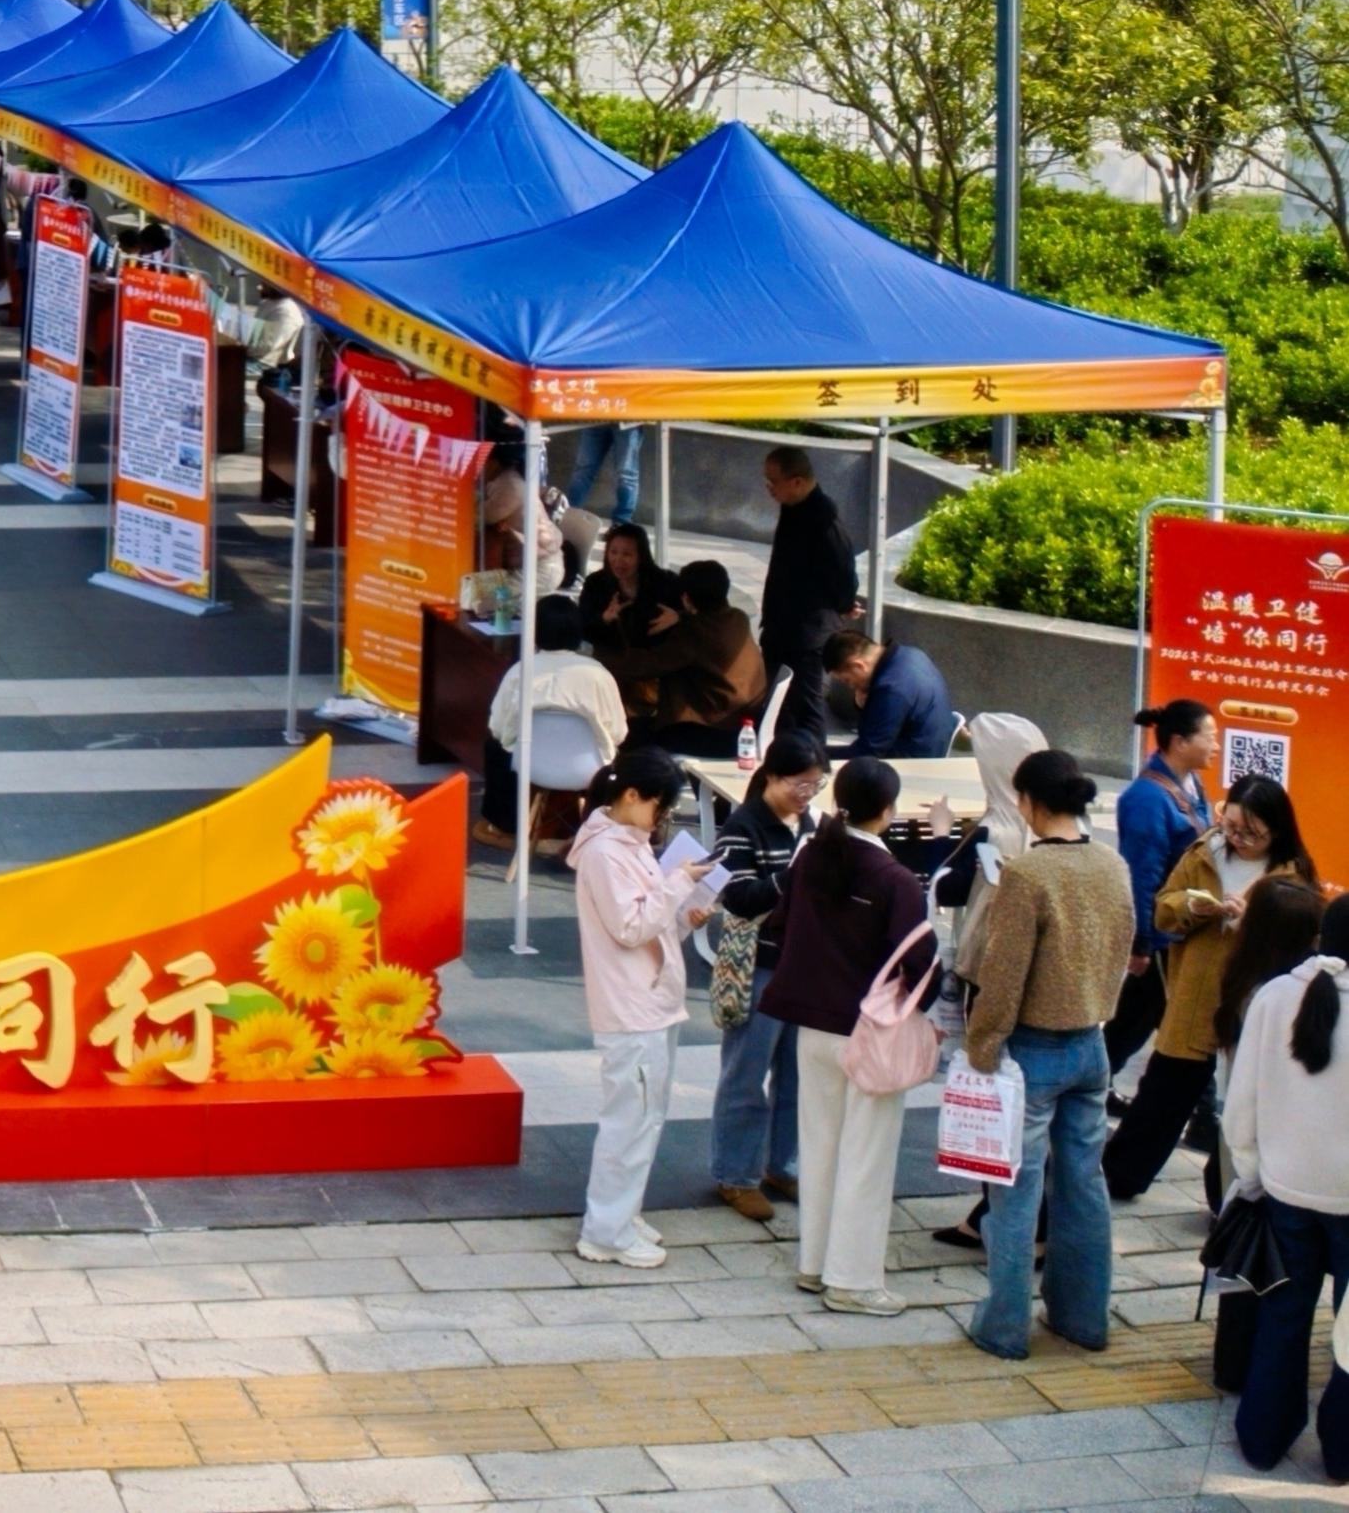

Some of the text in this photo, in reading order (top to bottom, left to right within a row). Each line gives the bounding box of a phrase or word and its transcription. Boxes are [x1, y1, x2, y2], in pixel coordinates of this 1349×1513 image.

[816, 376, 1000, 408] 签到处
[1201, 590, 1324, 626] 温暖卫健
